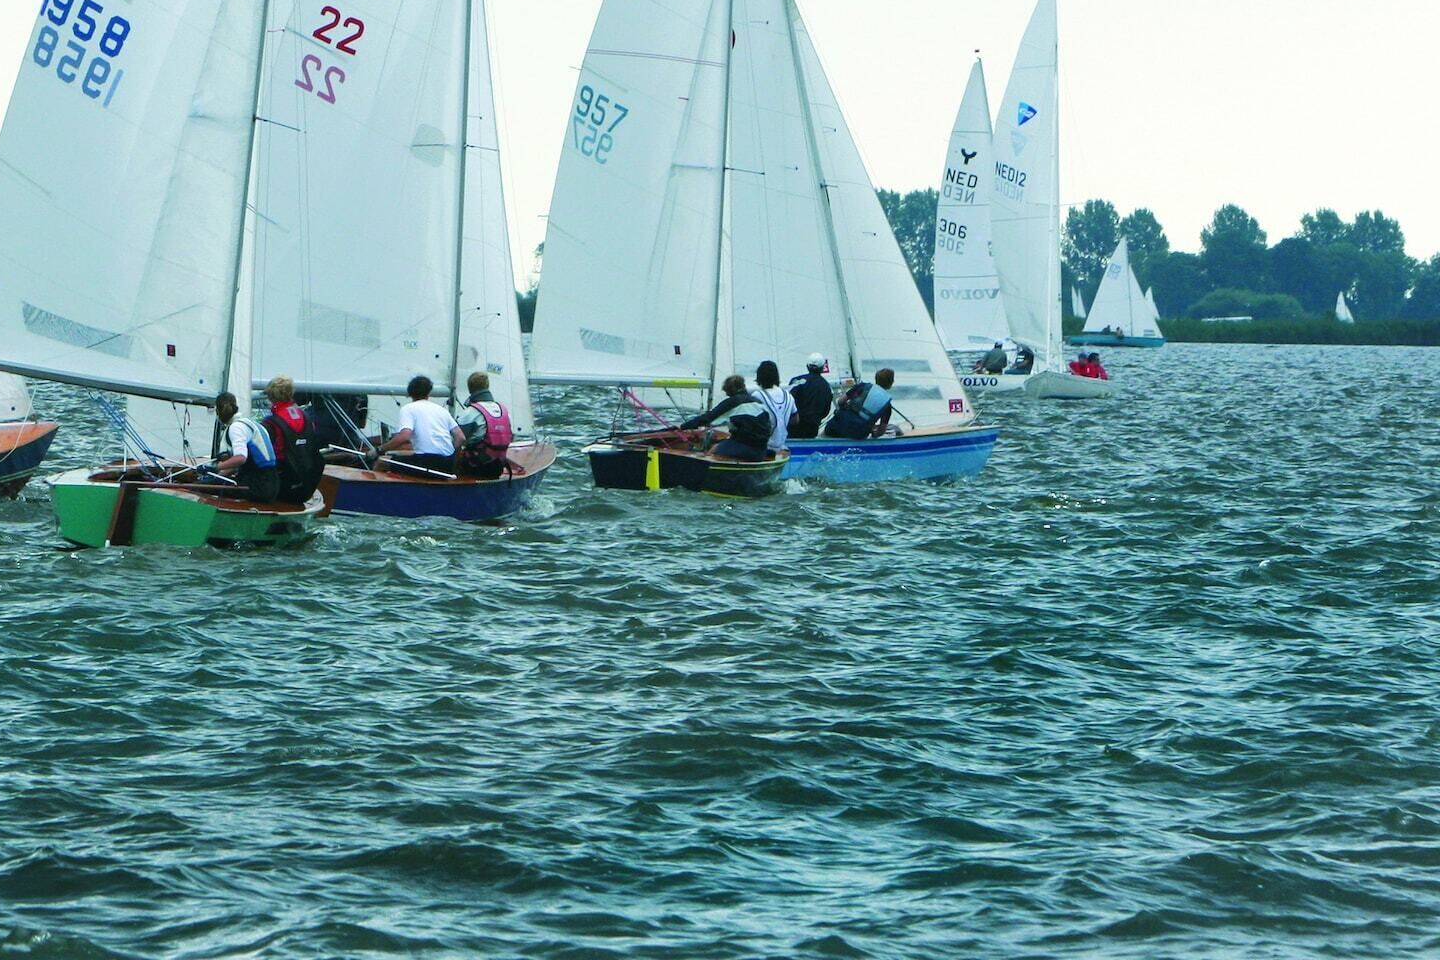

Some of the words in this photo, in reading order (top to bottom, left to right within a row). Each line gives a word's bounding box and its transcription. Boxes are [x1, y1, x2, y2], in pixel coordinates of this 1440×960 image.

[312, 5, 365, 56] 22
[576, 84, 629, 134] 957
[946, 167, 978, 189] NED
[939, 218, 968, 240] 306
